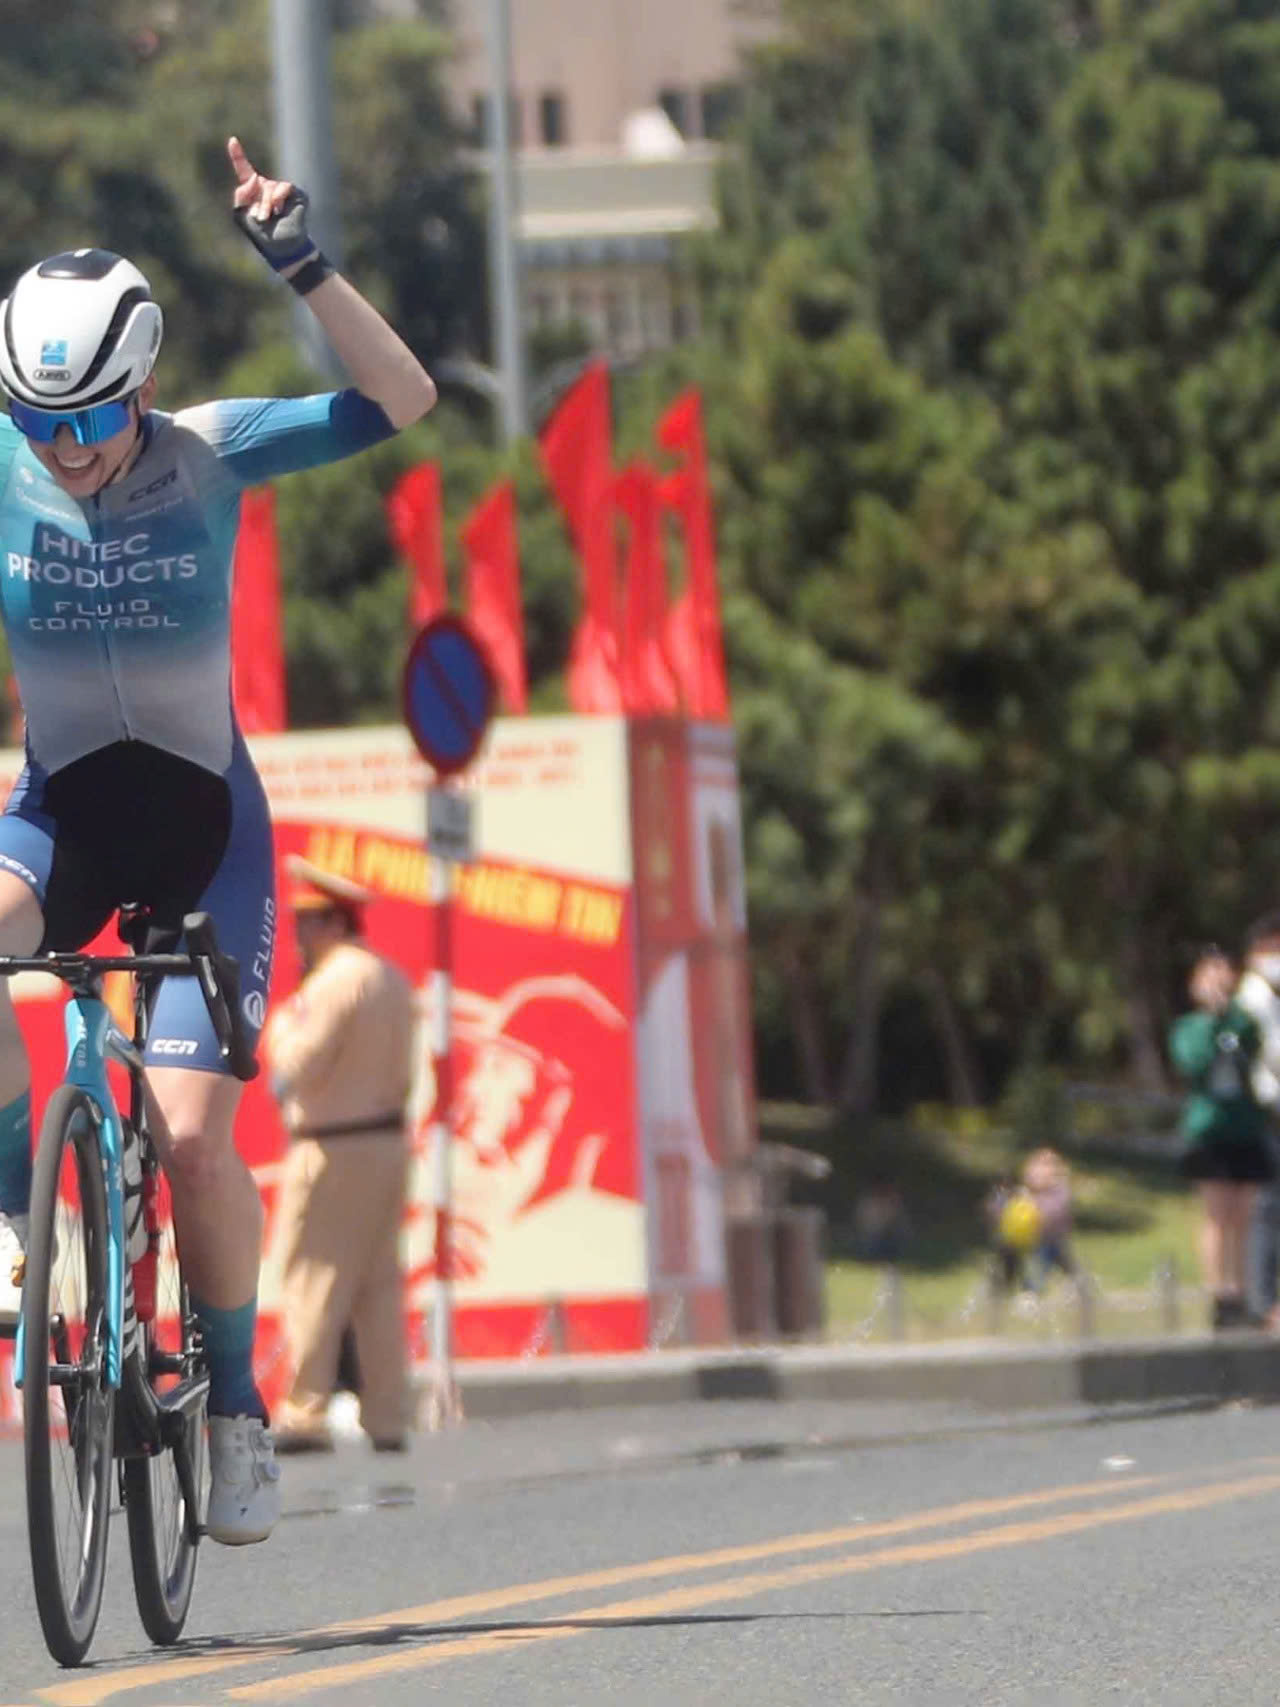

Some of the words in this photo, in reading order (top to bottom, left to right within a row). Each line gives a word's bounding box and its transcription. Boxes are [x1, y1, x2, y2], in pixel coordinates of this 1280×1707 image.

[41, 531, 150, 563] HITEC
[8, 552, 199, 589] PRODUCTS
[55, 599, 150, 616] FLUID
[28, 615, 180, 631] CONTROL
